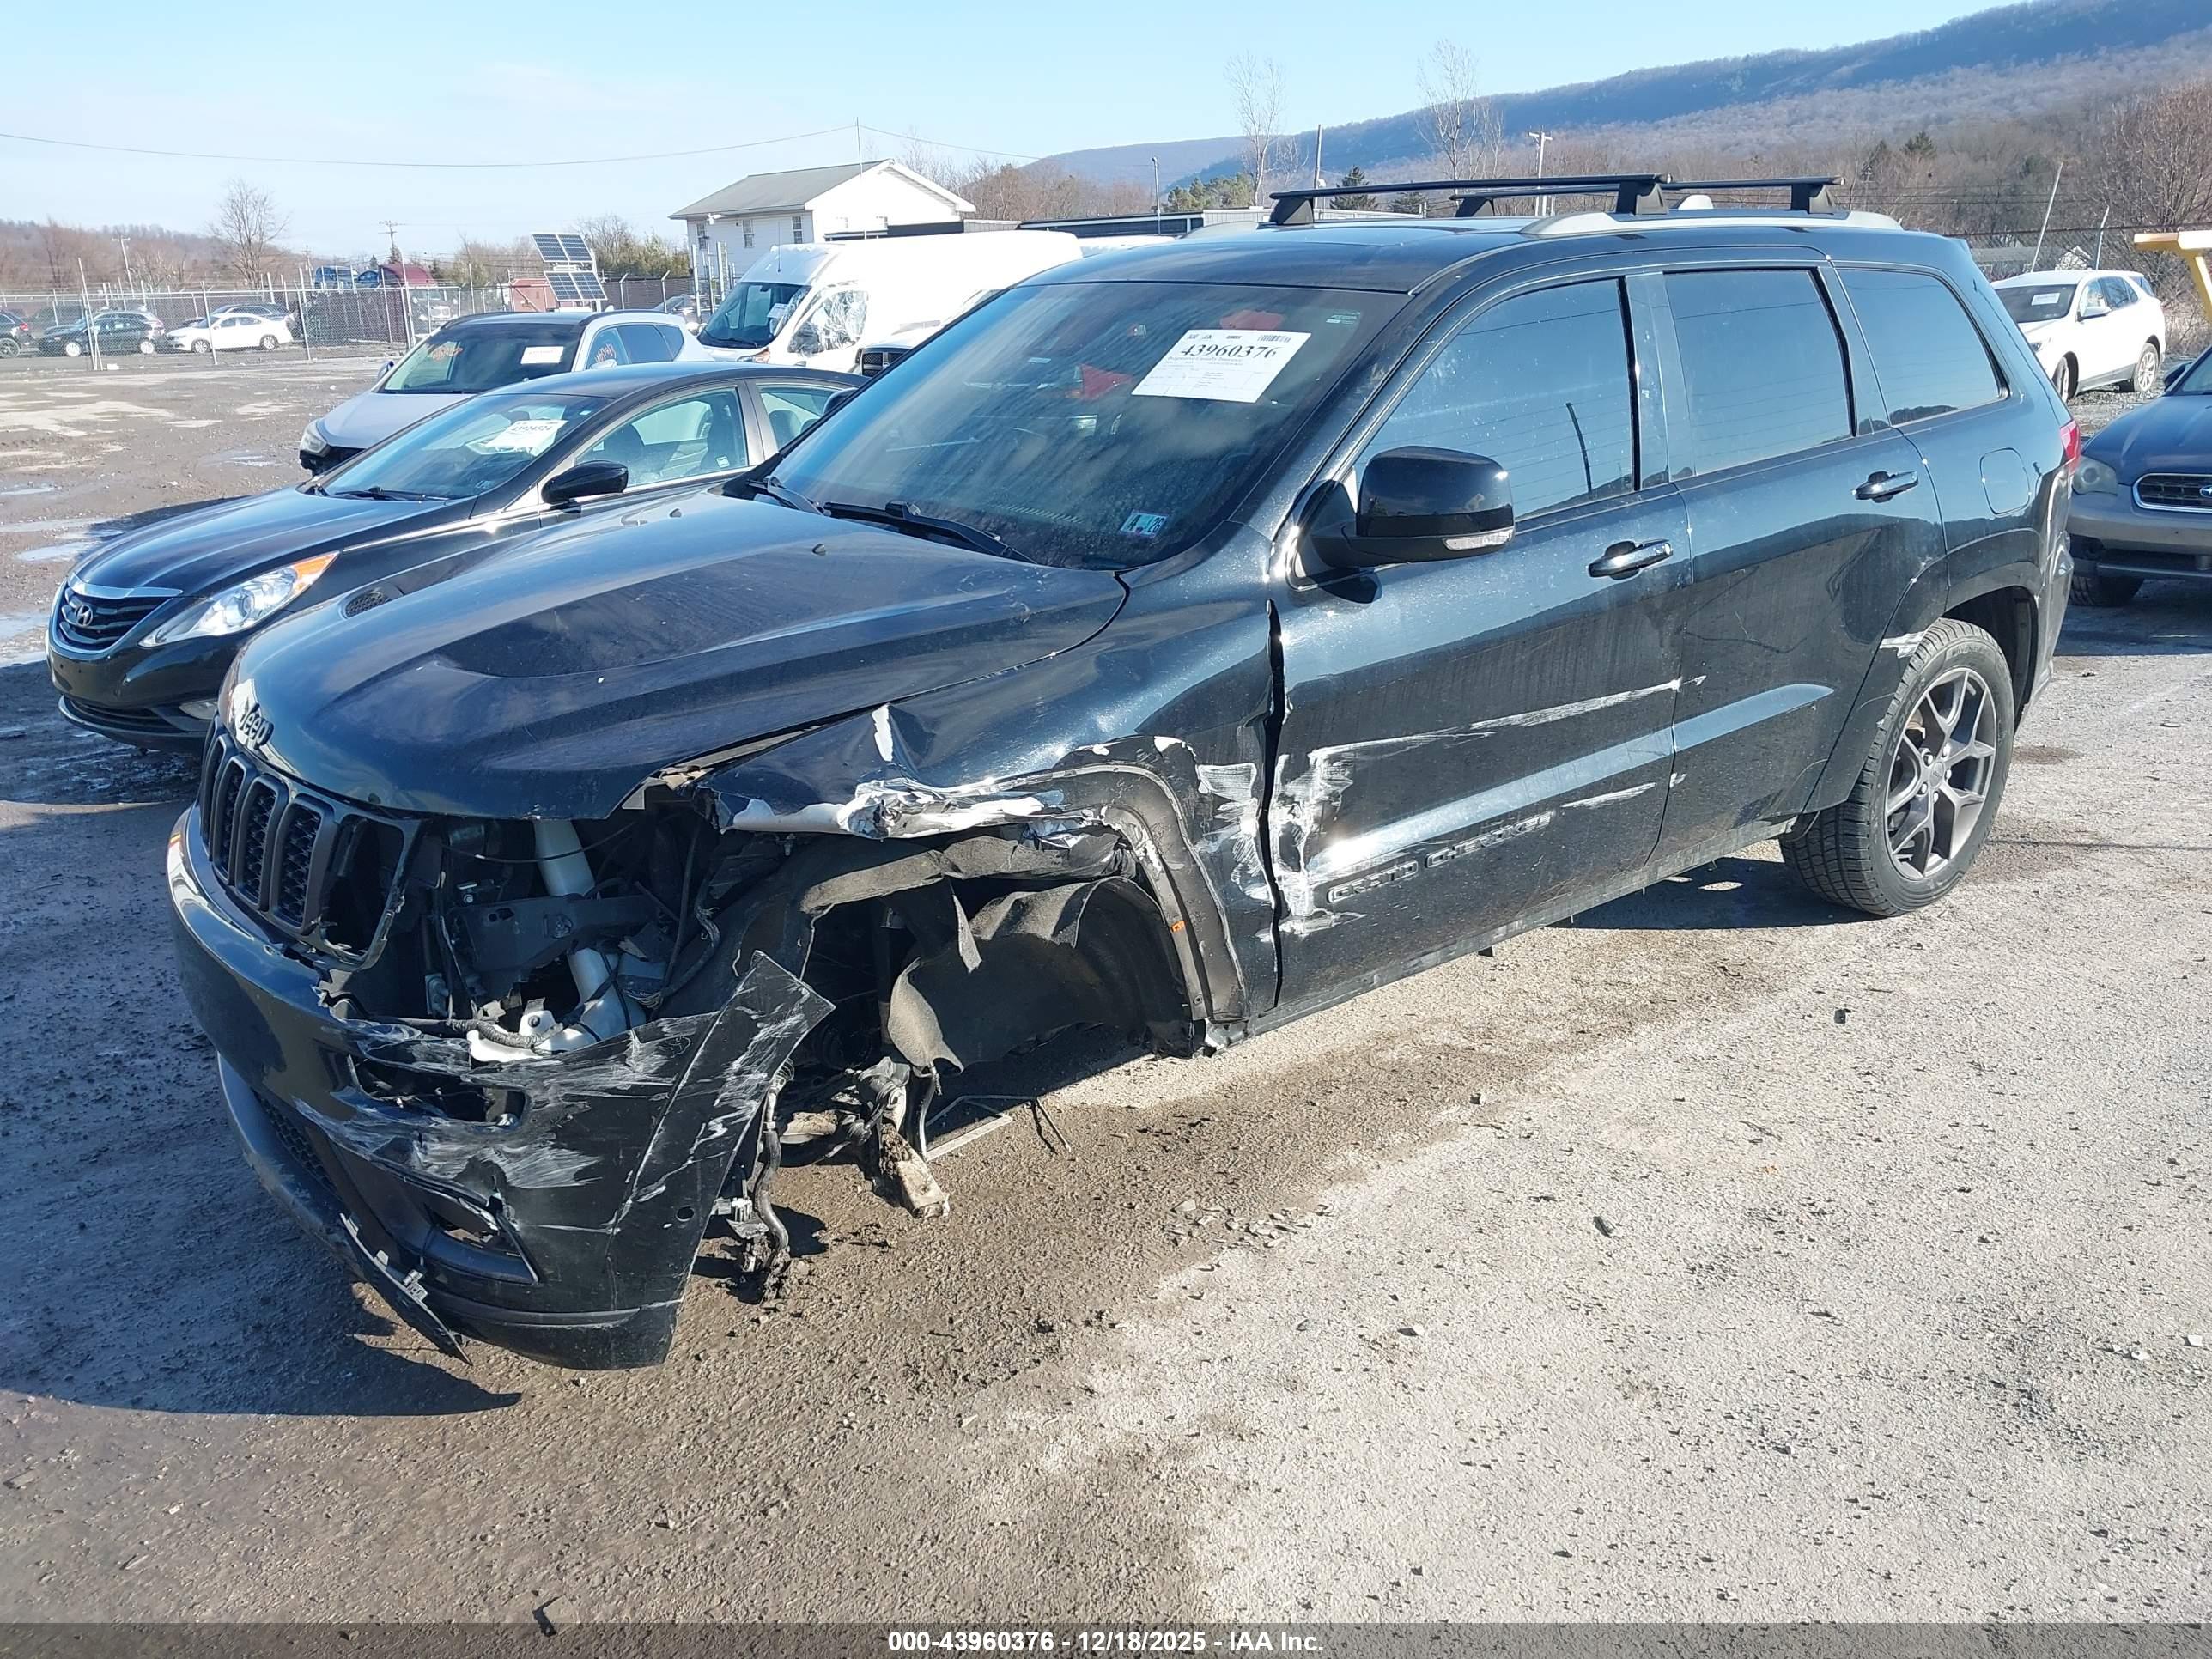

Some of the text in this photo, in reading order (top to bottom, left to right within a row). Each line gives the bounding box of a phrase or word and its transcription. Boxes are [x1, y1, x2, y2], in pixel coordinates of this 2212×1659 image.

[1181, 343, 1281, 358] 43960376
[1127, 514, 1165, 533] 4 26
[239, 697, 275, 750] Jeep
[1327, 810, 1554, 902] GRAND CHEROKEE
